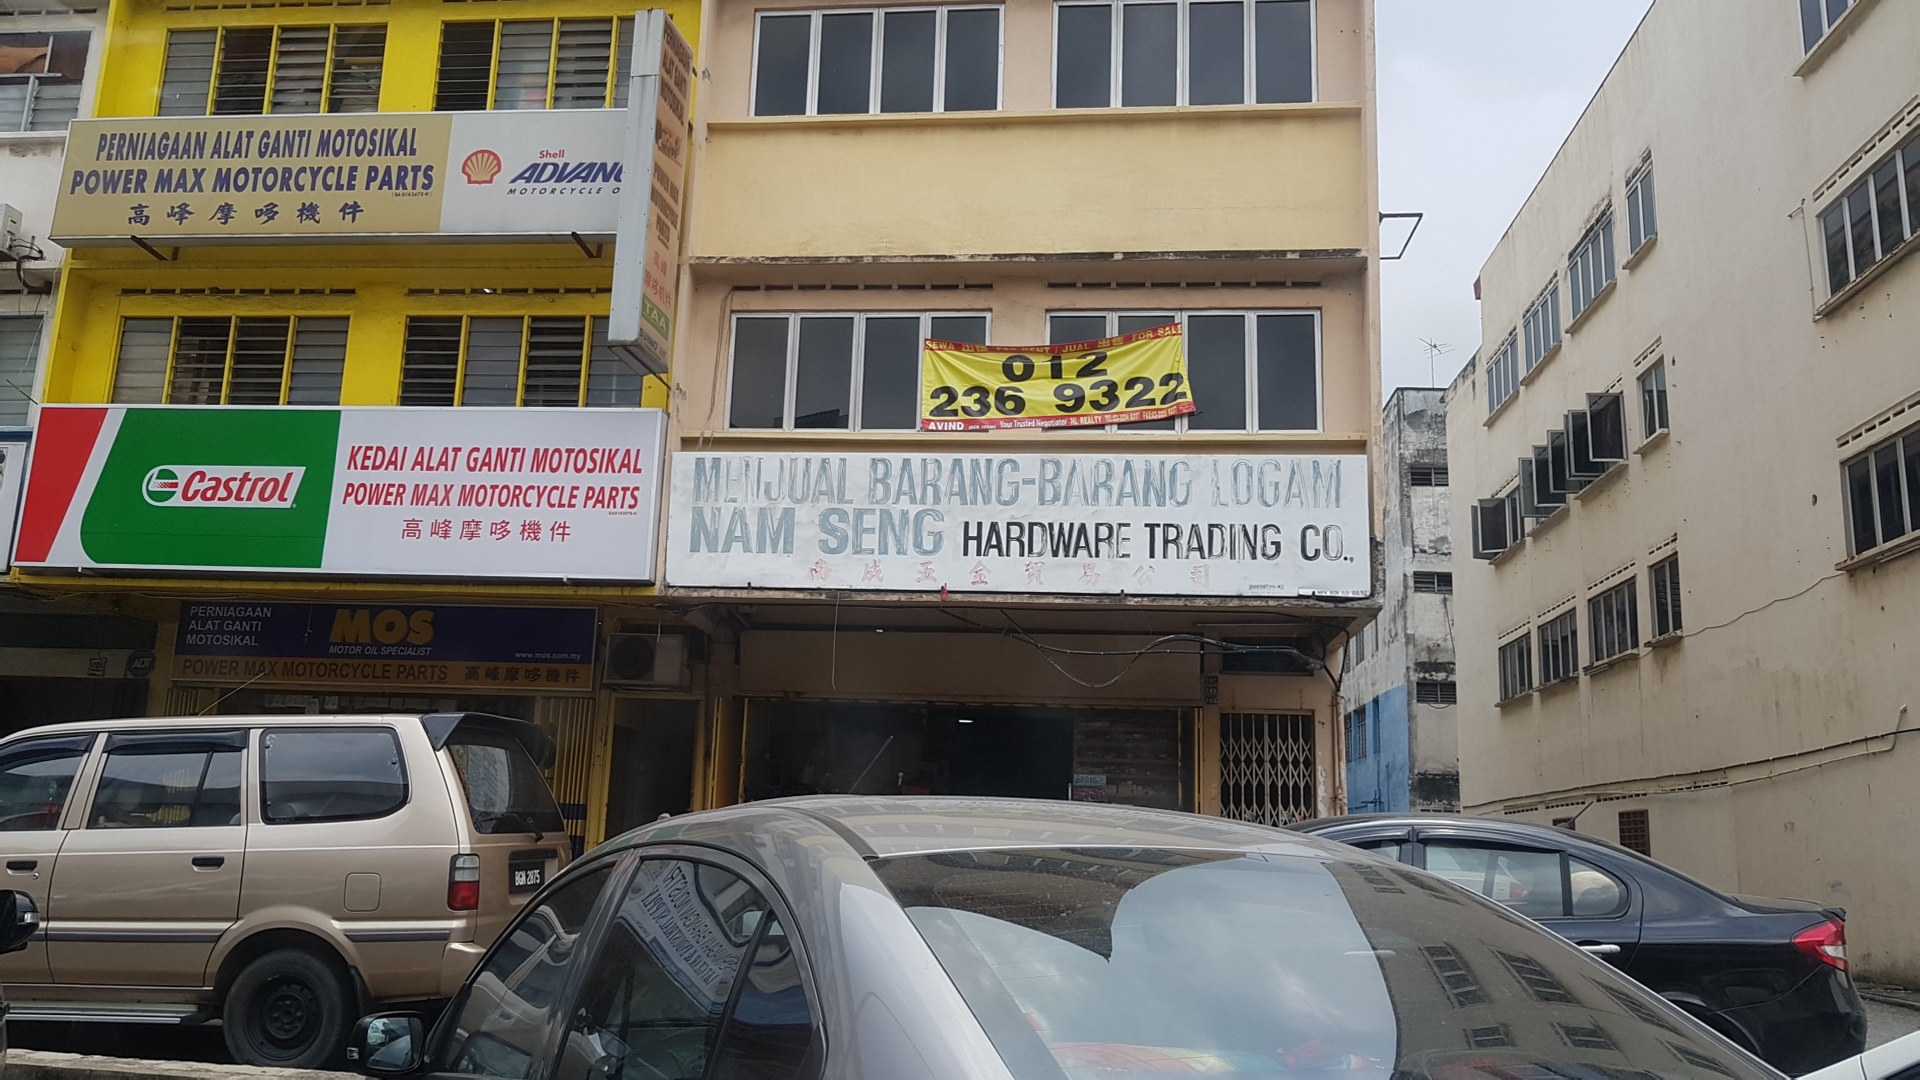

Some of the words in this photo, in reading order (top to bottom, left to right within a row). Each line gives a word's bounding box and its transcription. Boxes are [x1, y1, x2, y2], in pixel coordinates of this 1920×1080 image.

[96, 131, 206, 162] PERNIAGAAN
[210, 130, 254, 160] ALAT
[257, 129, 312, 158] GANTI
[315, 128, 417, 158] MOTOSIKAL
[538, 150, 565, 159] Shell
[70, 169, 148, 195] POWER
[154, 168, 204, 193] MAX
[212, 166, 357, 192] MOTORCYCLE
[364, 165, 434, 191] PARTS
[506, 187, 604, 195] MOTORCYCLE
[127, 201, 365, 226] 高峰摩哆機件
[644, 300, 667, 332] TAA
[1132, 330, 1154, 342] FOR
[1158, 324, 1182, 336] SALE
[1002, 352, 1108, 382] 012
[928, 386, 1026, 417] 236
[1053, 372, 1188, 413] 9322
[928, 422, 964, 430] AVIND
[1000, 420, 1013, 428] Your
[1014, 420, 1035, 428] Trusted
[1036, 419, 1068, 428] Negotiator
[346, 446, 408, 472] KEDAI
[411, 446, 462, 472] ALAT
[466, 446, 528, 473] GANTI
[530, 448, 642, 474] MOTOSIKAL
[181, 470, 294, 502] Castrol
[868, 458, 1192, 508] BARANG-BARANG
[1211, 458, 1342, 509] LOGAM
[342, 482, 406, 506] POWER
[410, 483, 454, 507] MAX
[457, 484, 580, 509] MOTORCYCLE
[582, 486, 640, 510] PARTS
[400, 518, 572, 542] 高峰摩哆機件
[689, 506, 796, 554] NAM
[818, 507, 945, 556] SENG
[962, 521, 1131, 560] HARDWARE
[1144, 522, 1282, 562] TRADING
[190, 606, 272, 618] PERNIAGAAN
[188, 620, 220, 631] ALAT
[223, 621, 262, 632] GANTI
[329, 608, 435, 645] MOS
[186, 634, 259, 646] MOTOSIKAL
[328, 646, 362, 654] MOTOR
[364, 646, 380, 655] OIL
[380, 646, 432, 656] SPECIALIST
[515, 652, 582, 660] www.mos.com.my
[182, 658, 239, 676] POWER
[244, 660, 277, 677] MAX
[282, 662, 391, 680] MOTORCYCLE
[396, 664, 448, 681] PARTS
[465, 666, 580, 684] 高峰摩哆機件
[514, 870, 526, 886] BGN
